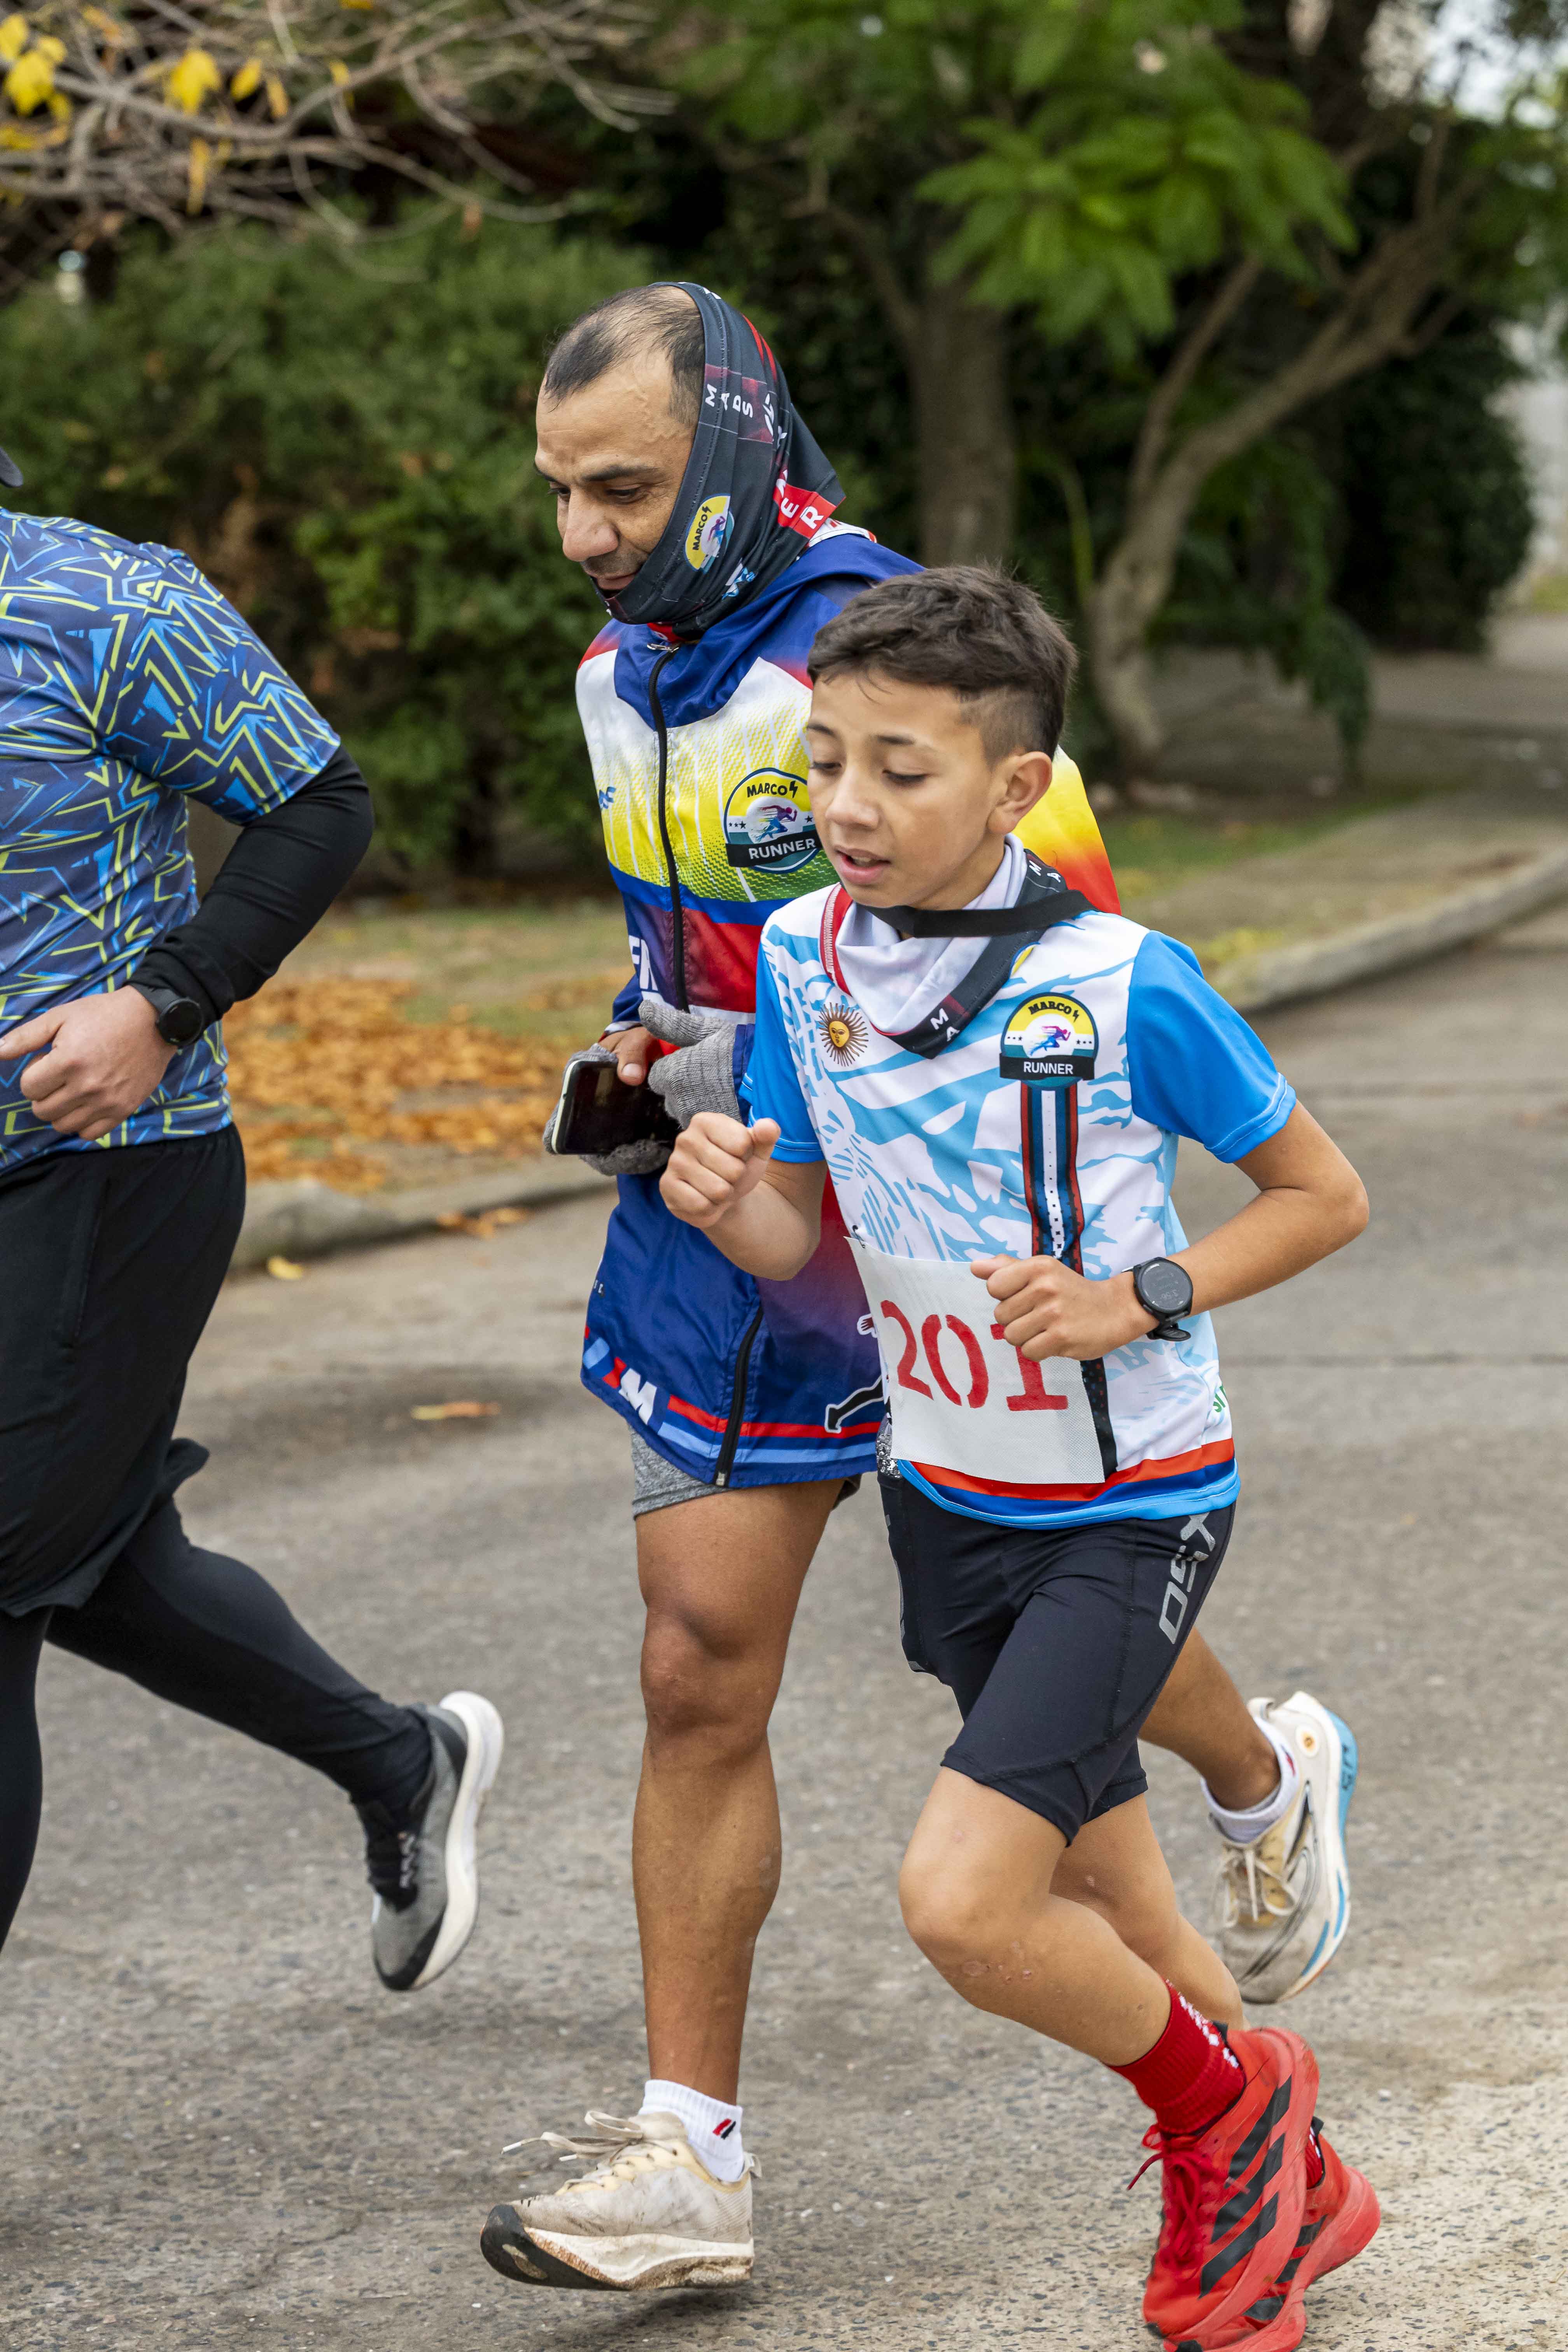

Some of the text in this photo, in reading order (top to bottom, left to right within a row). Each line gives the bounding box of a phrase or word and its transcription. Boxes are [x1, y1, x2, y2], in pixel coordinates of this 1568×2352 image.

[748, 838, 816, 859] RUNNER
[1023, 1061, 1074, 1074] RUNNER
[880, 1300, 1069, 1411] 201
